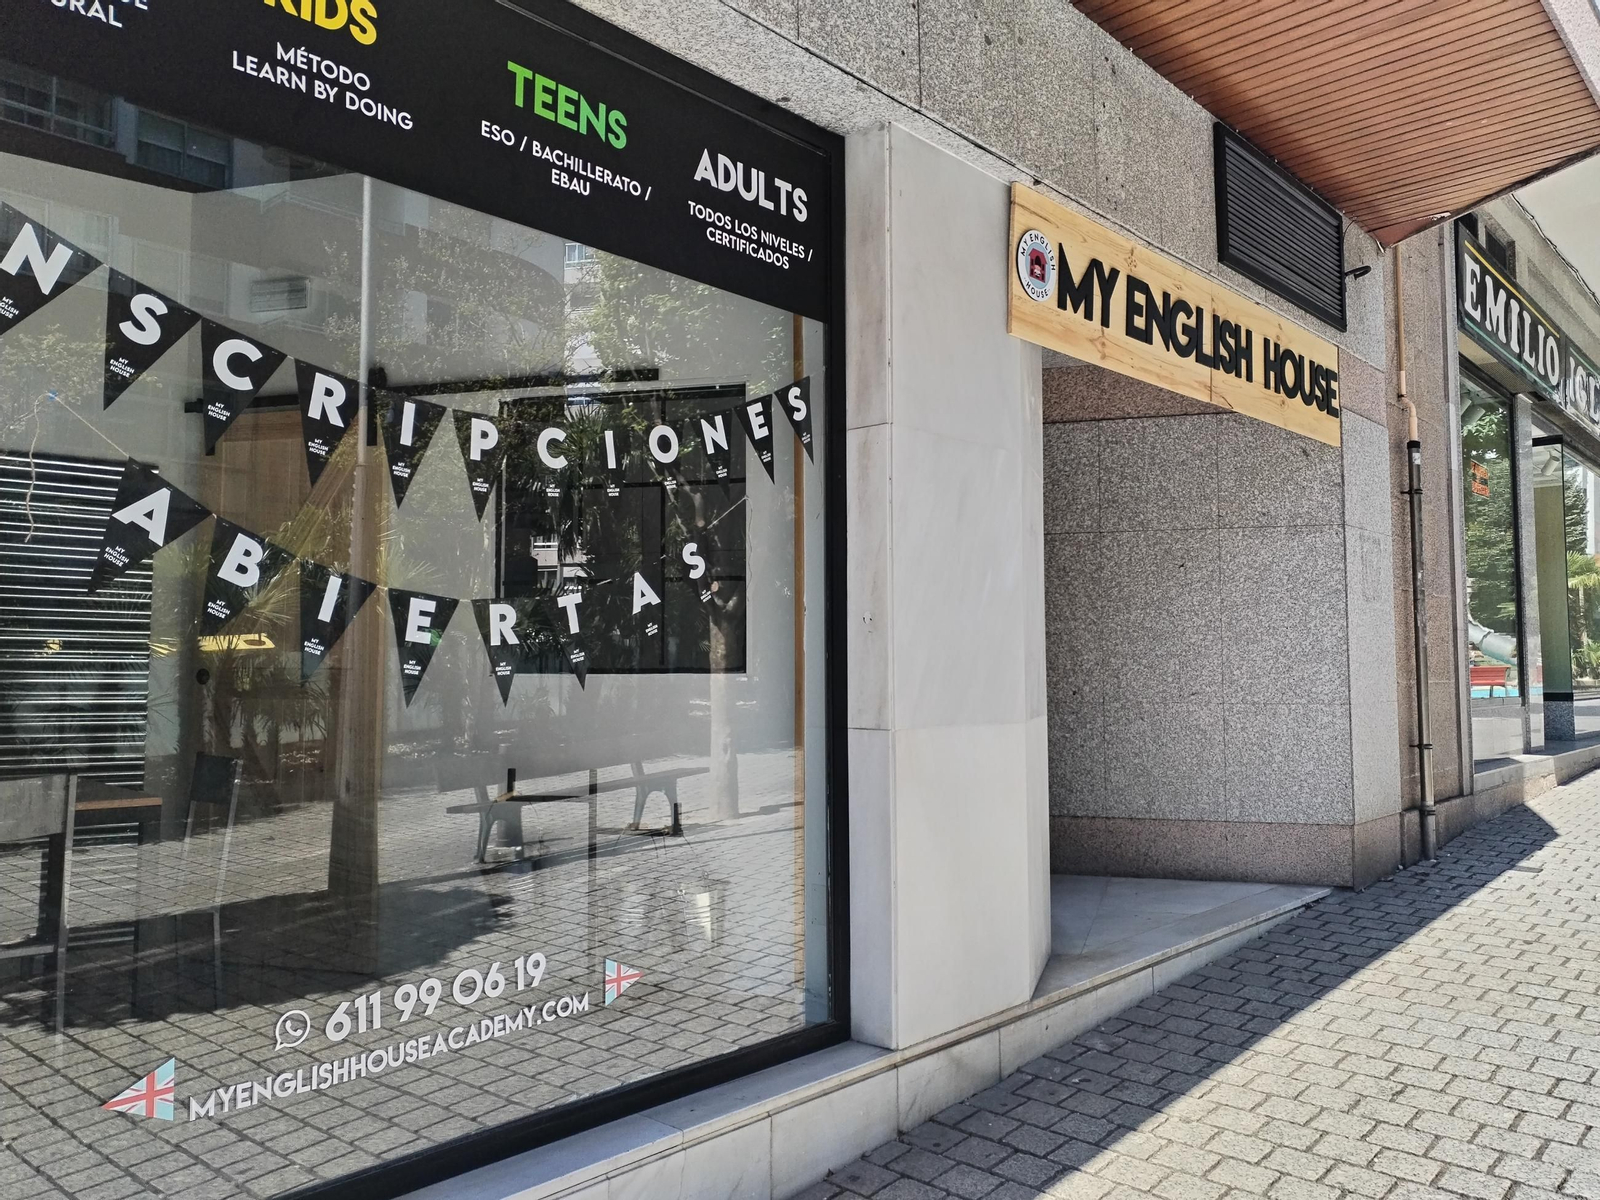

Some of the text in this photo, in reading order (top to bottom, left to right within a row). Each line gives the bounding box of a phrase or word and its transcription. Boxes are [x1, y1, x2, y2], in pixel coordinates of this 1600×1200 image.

[264, 0, 378, 45] DS
[276, 41, 371, 91] MÉTODO
[232, 50, 413, 130] LEARN BY DOING
[507, 60, 628, 150] TEENS
[481, 120, 515, 146] ESO
[532, 140, 641, 196] BACHILLERATO
[551, 168, 591, 196] EBAU
[693, 148, 808, 222] ADULTS
[688, 200, 732, 229] TODOS
[735, 219, 758, 240] LOS
[761, 230, 805, 259] NIVELES
[706, 227, 789, 269] CERTIFICADOS
[1020, 233, 1056, 271] MY ENGLISH
[1025, 281, 1049, 299] HOUSE
[0, 307, 14, 319] USE
[1057, 242, 1340, 419] MY ENGLISH HOUSE
[1464, 252, 1560, 386] EMILIO
[110, 359, 134, 374] ENGLISH
[110, 365, 130, 378] HOUSE
[103, 552, 124, 567] HOUSE
[105, 546, 130, 564] ENGLISH
[115, 545, 126, 554] MY
[325, 952, 547, 1042] 611 99 06 19
[188, 991, 589, 1122] MYENGLISHHOUSEACADEMY.COM
